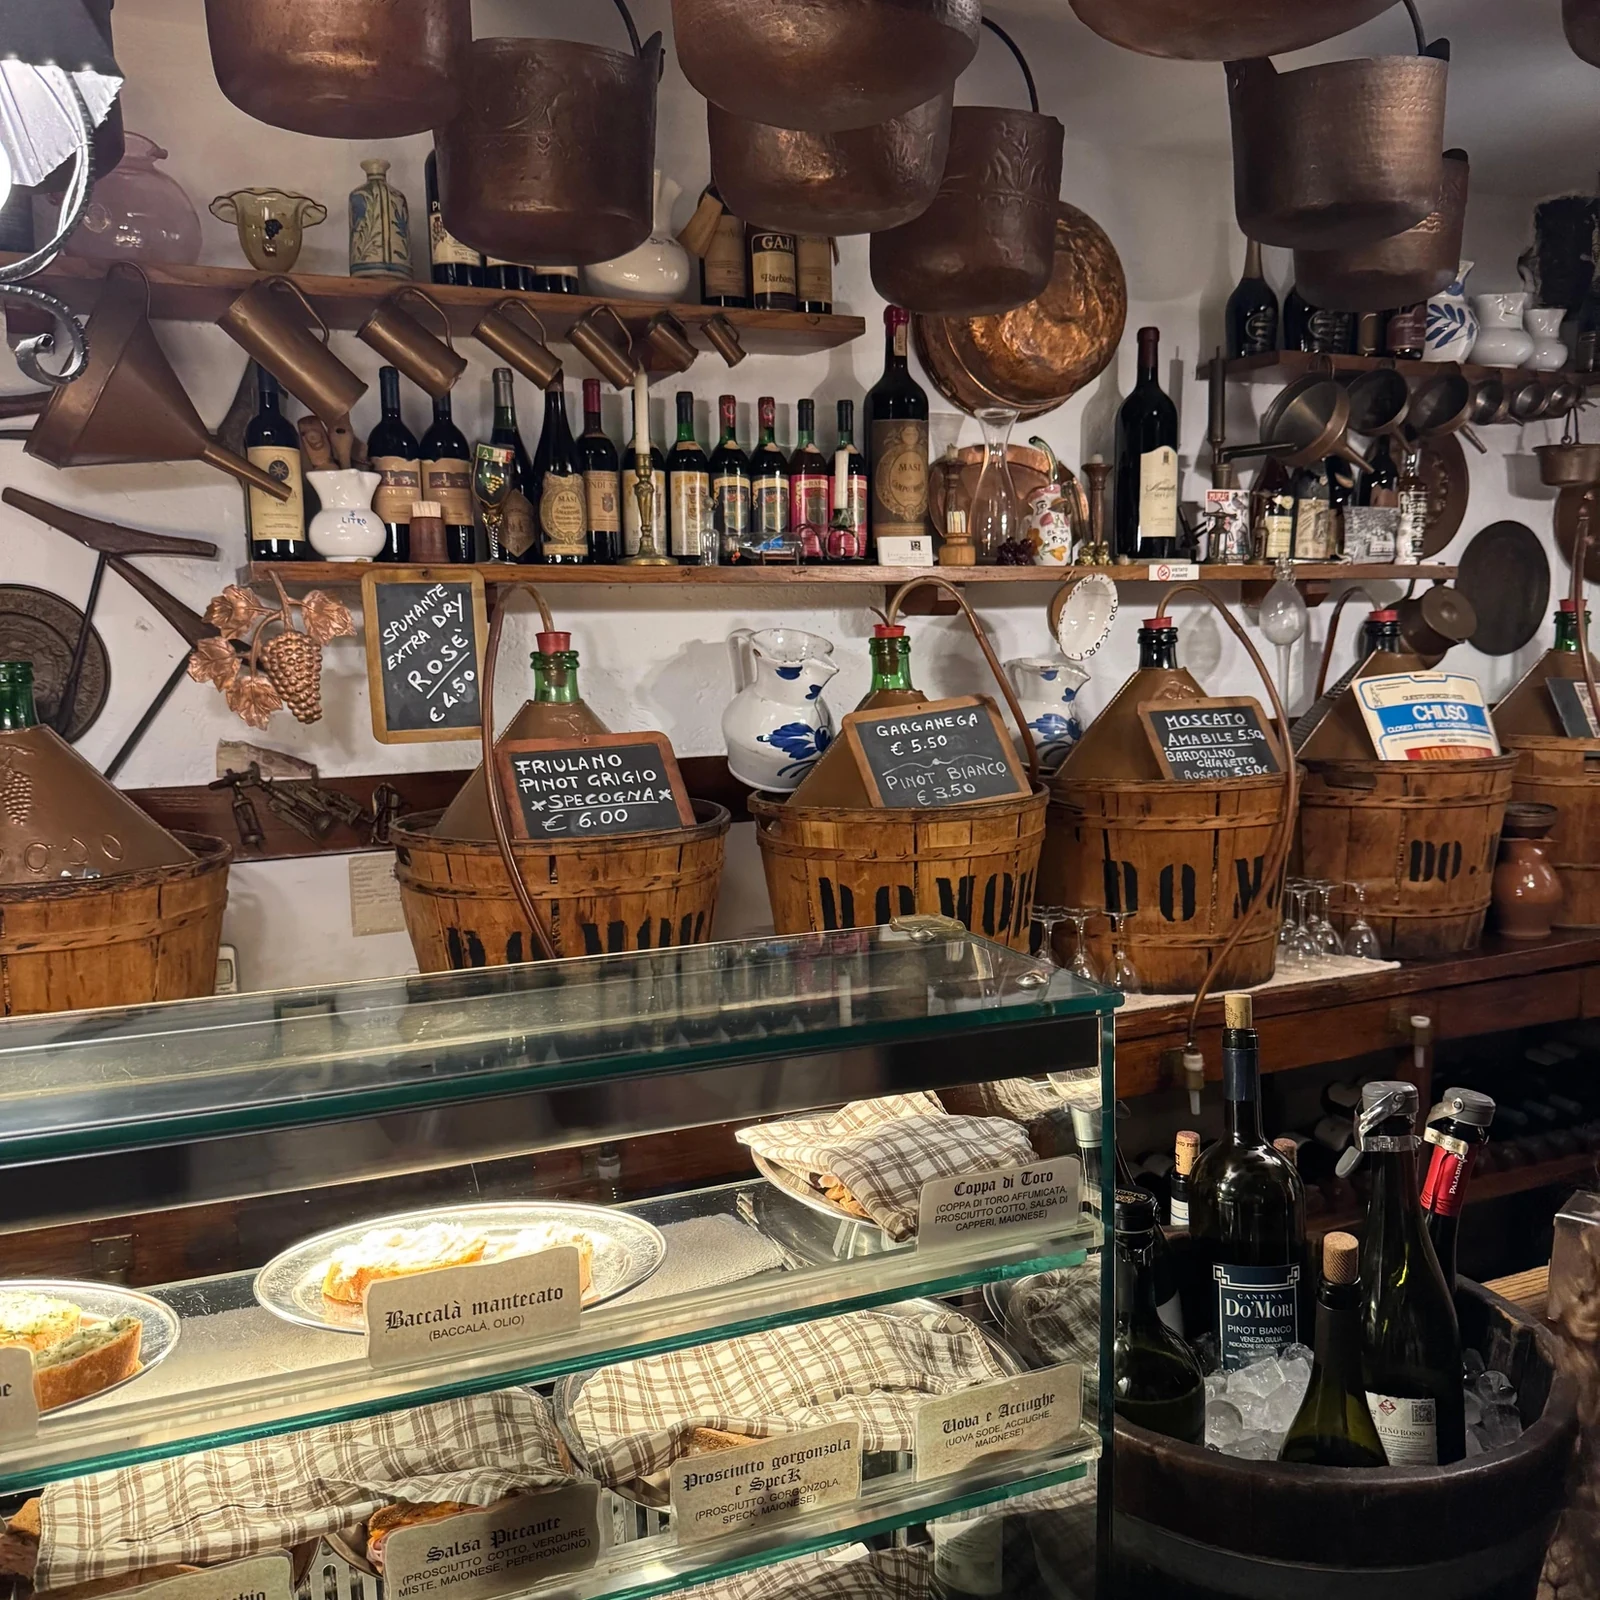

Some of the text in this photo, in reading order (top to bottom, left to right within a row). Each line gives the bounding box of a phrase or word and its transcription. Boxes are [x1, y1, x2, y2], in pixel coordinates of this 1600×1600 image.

[899, 464, 921, 472] MASI
[383, 583, 448, 645] SPUMANTE
[387, 592, 464, 671] EXTRA DRY
[442, 670, 475, 708] 4.50
[1164, 713, 1246, 728] MOSCATO
[1412, 704, 1469, 721] CHIUSO
[876, 713, 979, 737] GARGANEGA
[890, 735, 948, 756] € 5.50
[1168, 732, 1234, 747] AMABILE
[514, 754, 622, 776] FRIULANO
[1166, 748, 1236, 763] BARDOLINO
[1196, 756, 1256, 768] CHIARETTO
[520, 769, 657, 794] PINOT GRIGIO
[885, 761, 1006, 790] PINOT BIANCO
[1184, 769, 1228, 780] ROSATO
[917, 784, 976, 806] € 3.50
[542, 808, 628, 832] € 6.00
[954, 1170, 1054, 1196] Coppa di Toro
[934, 1196, 1068, 1224] PROSCIUTTO COTTO, SALSA DI
[936, 1186, 1068, 1214] (COPPA DI TORO AFFUMICATA,
[956, 1210, 1048, 1232] CAPPERI, MAIONESE)
[385, 1286, 564, 1334] Baccalà mantecato
[429, 1315, 525, 1342] (BACCALÀ, OLIO)
[1228, 1324, 1292, 1335] PINOT BIANCO
[942, 1393, 1056, 1434] Uova e Acciughe
[945, 1412, 1052, 1448] (UOVA SODE, ACCIUGHE,
[974, 1428, 1024, 1448] MAIONESE)
[683, 1439, 851, 1491] Prosciutto gorgonzola
[735, 1486, 742, 1496] e
[769, 1478, 841, 1502] GORGONZOLA,
[722, 1494, 817, 1525] SPECK, MAIONESE)
[426, 1516, 561, 1564] Salsa Piccante
[398, 1538, 592, 1598] MISTE, MAIONESE, PEPERONCINO)
[402, 1556, 482, 1586] (PROSCIUTTO
[532, 1528, 586, 1549] VERDURE
